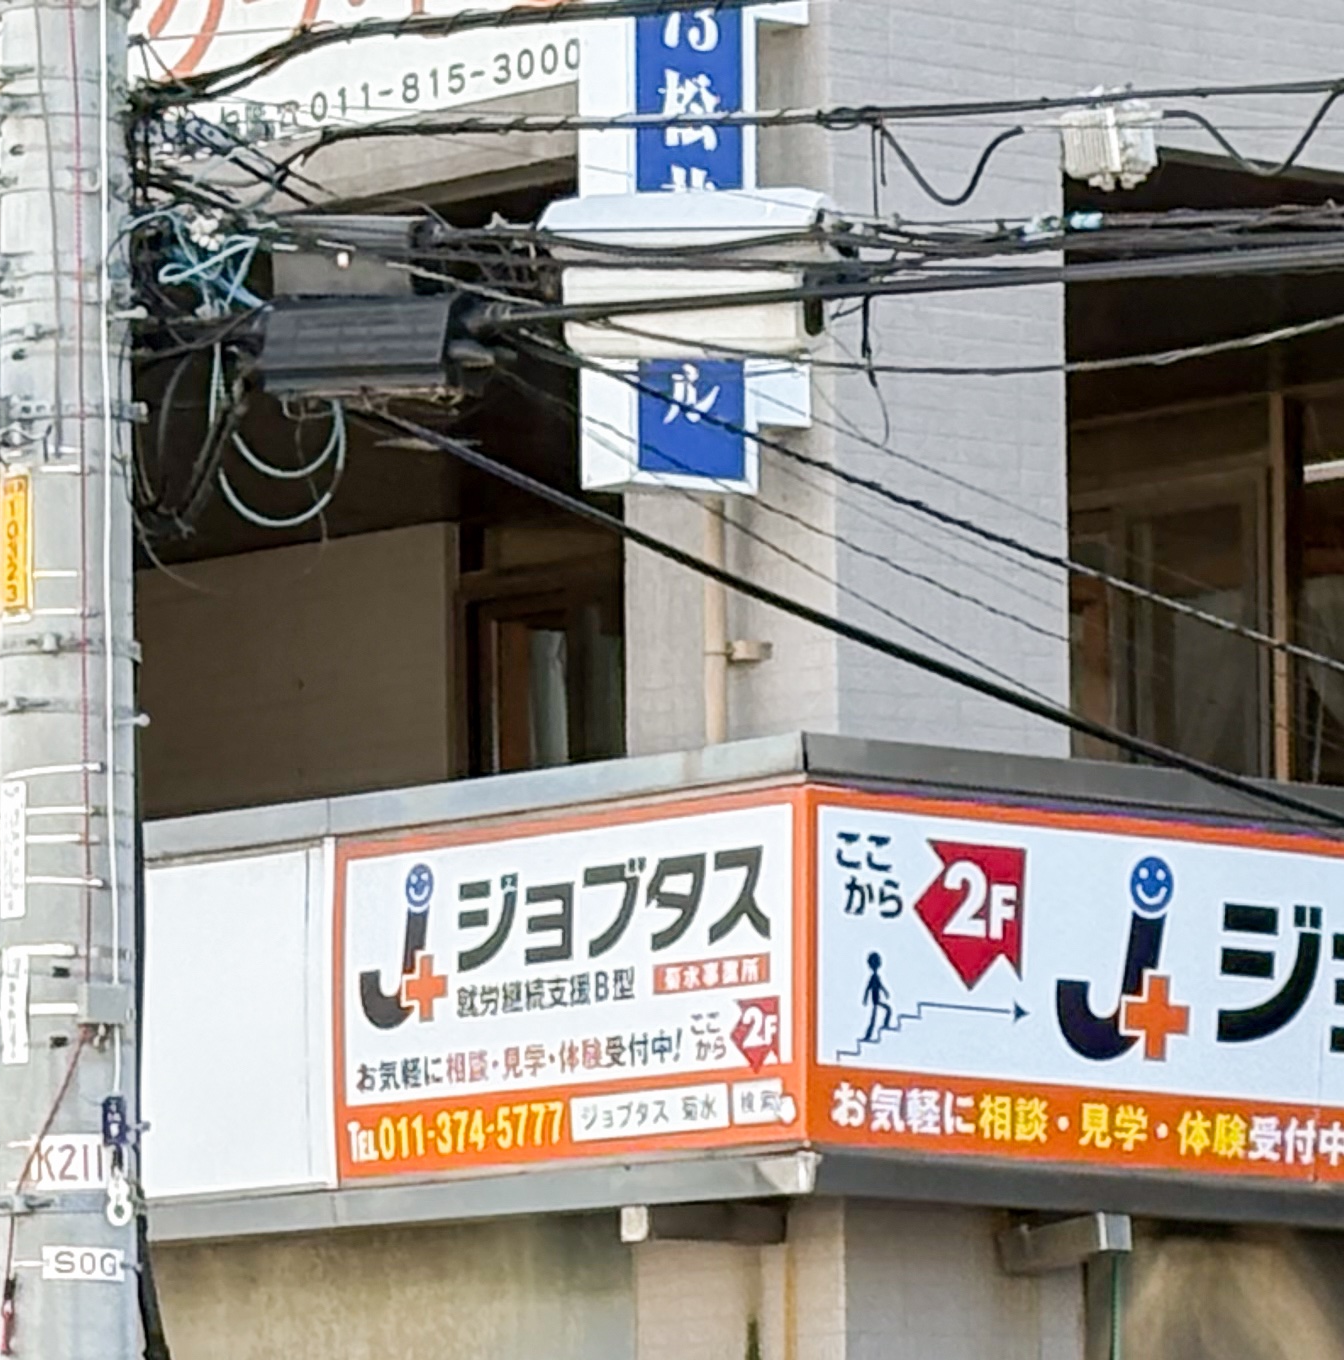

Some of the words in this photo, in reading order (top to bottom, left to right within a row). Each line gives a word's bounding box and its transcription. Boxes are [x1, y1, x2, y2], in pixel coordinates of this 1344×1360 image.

[836, 832, 892, 872] ここ
[457, 845, 771, 972] ジョブタス
[844, 877, 903, 919] から
[942, 860, 1017, 941] 2F
[457, 967, 635, 1019] 就労継続支援B型
[742, 1007, 778, 1049] 2F
[581, 1101, 671, 1131] ジョブタス
